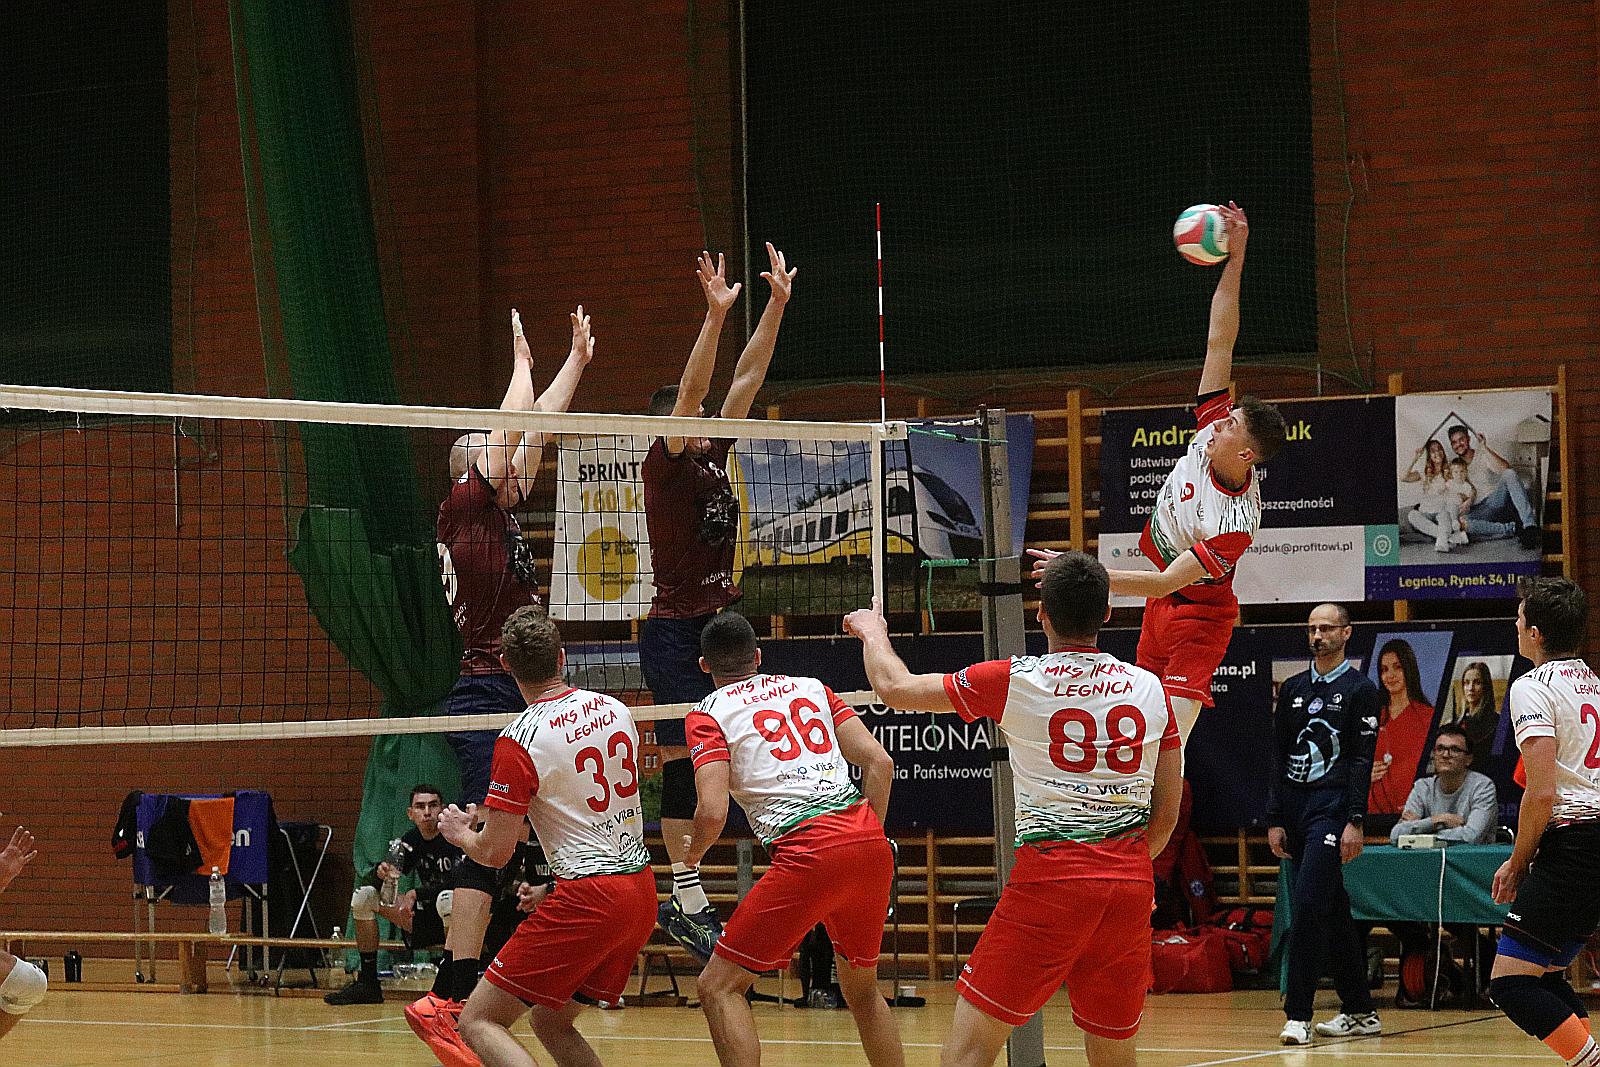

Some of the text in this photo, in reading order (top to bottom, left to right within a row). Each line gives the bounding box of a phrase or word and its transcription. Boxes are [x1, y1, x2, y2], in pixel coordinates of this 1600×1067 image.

[1131, 425, 1198, 448] Andrz
[578, 461, 643, 481] SPRINT
[1130, 473, 1168, 486] podjęc
[1450, 574, 1486, 588] Rynek
[1045, 662, 1134, 680] MKS IKAR
[726, 680, 755, 698] MKS
[743, 682, 799, 705] LEGNICA
[1053, 680, 1133, 698] LEGNICA
[549, 696, 611, 730] MKS IKAR
[565, 710, 618, 745] LEGNICA
[752, 697, 833, 761] 96
[1048, 704, 1147, 774] 88
[574, 730, 638, 813] 33
[913, 763, 992, 780] Państwowa
[1097, 784, 1130, 795] Vita
